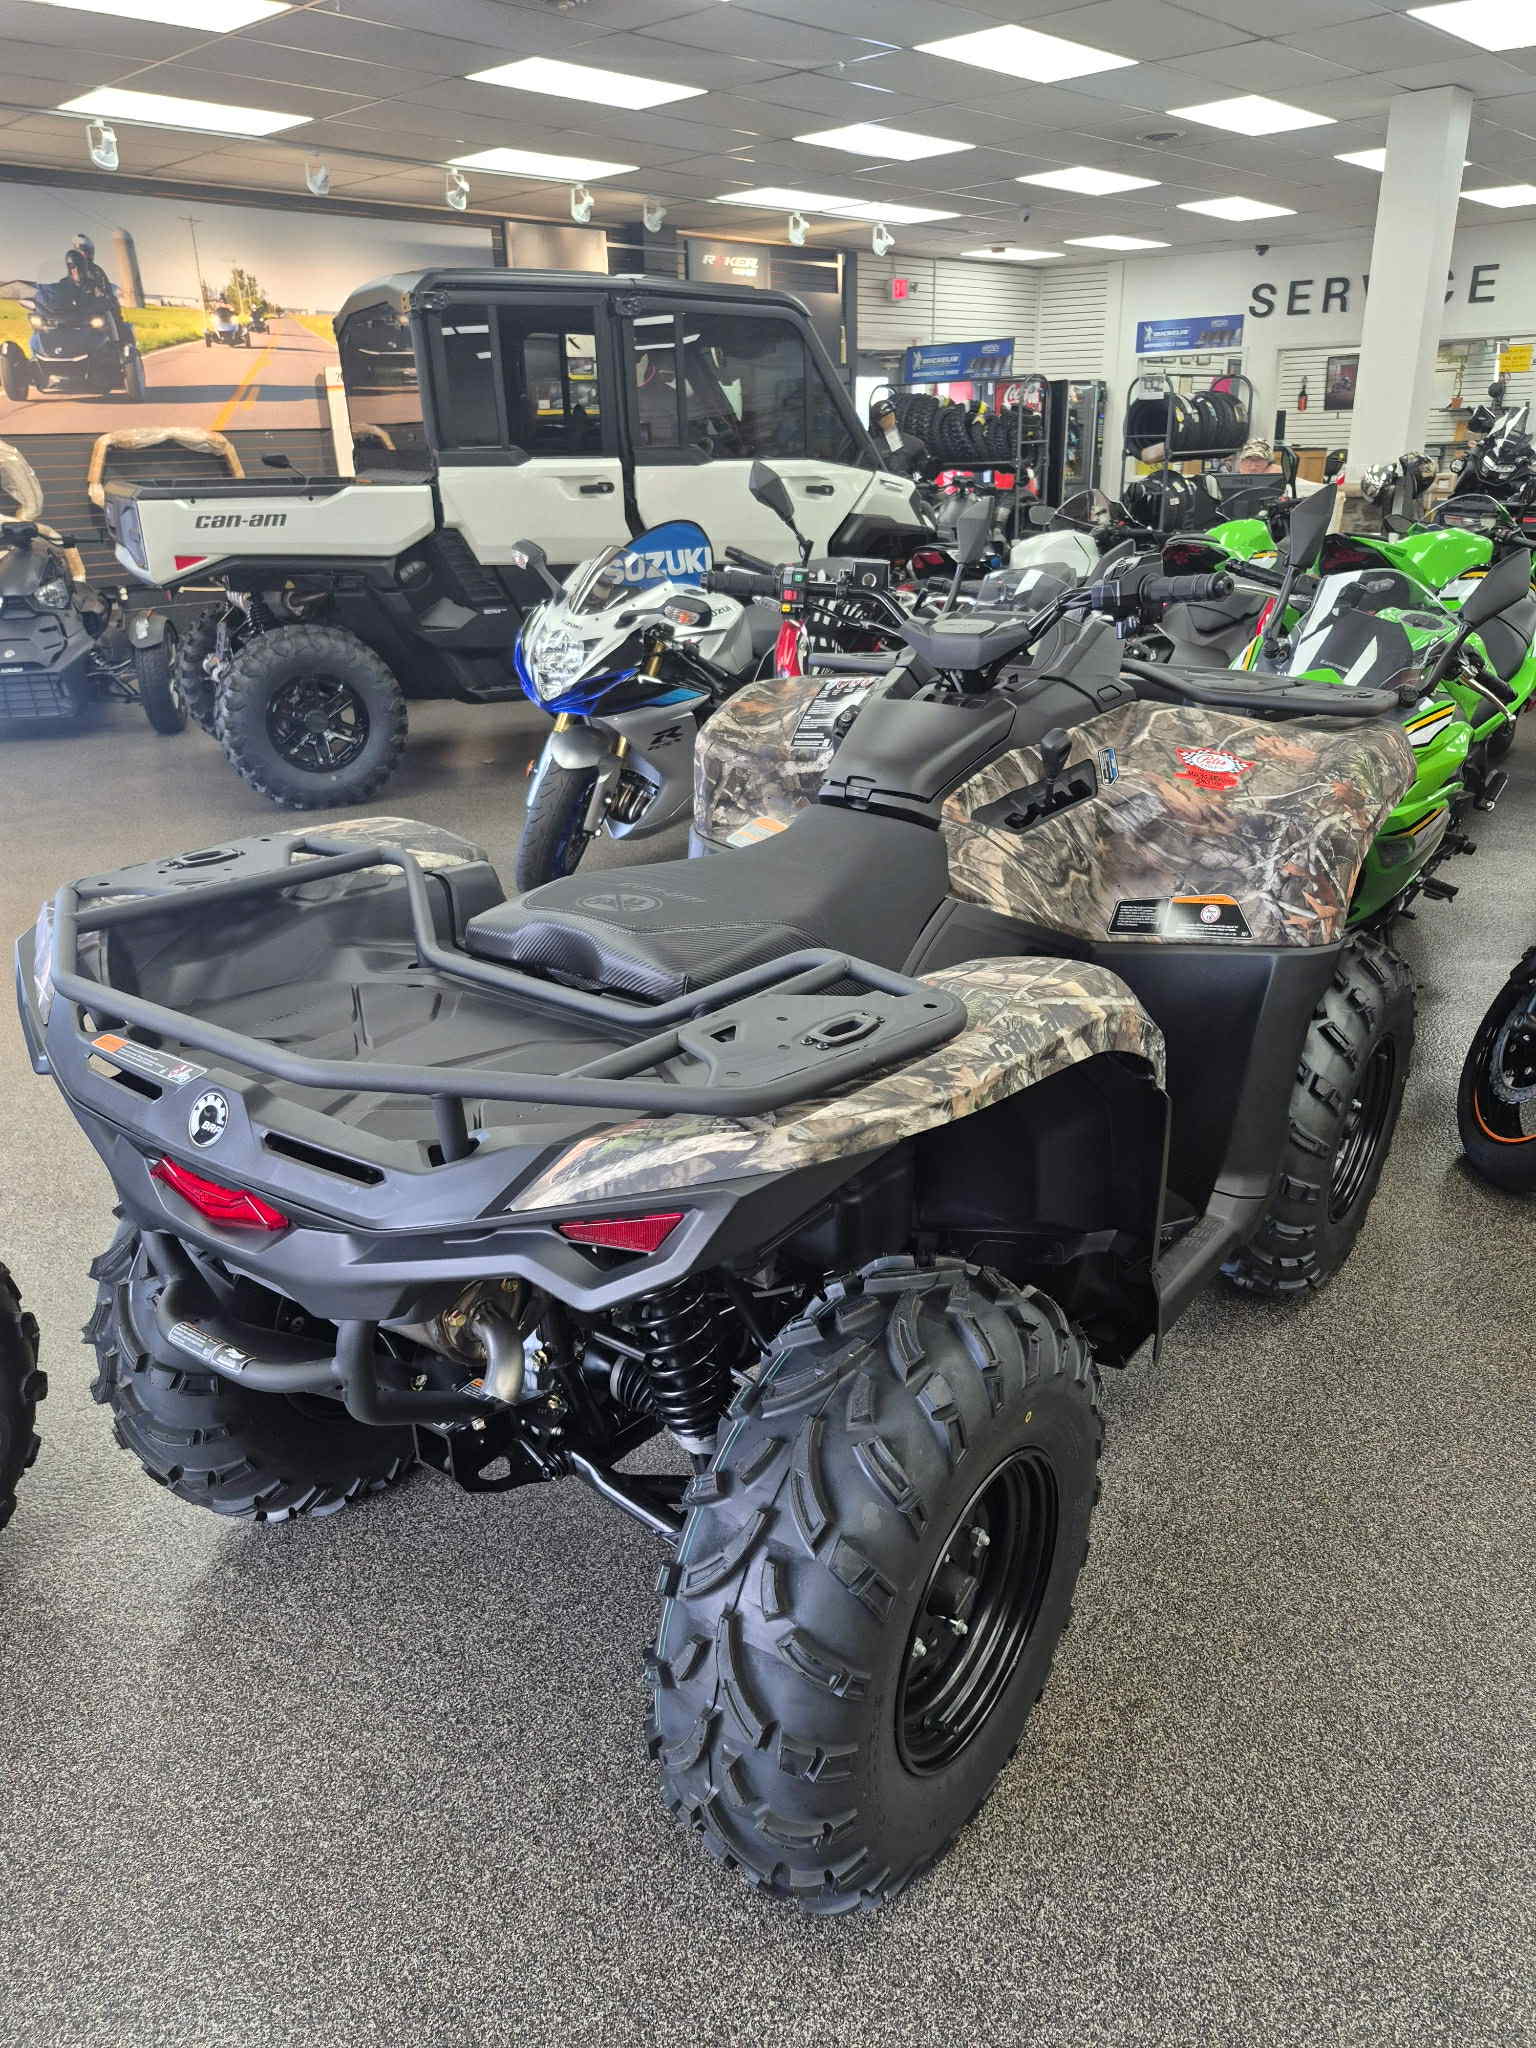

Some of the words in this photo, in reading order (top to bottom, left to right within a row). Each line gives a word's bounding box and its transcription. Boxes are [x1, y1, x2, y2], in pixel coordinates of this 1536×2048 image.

[1249, 263, 1500, 318] SERE
[195, 513, 287, 529] can-am
[604, 546, 712, 585] SUZUKI
[201, 1120, 223, 1134] BRP
